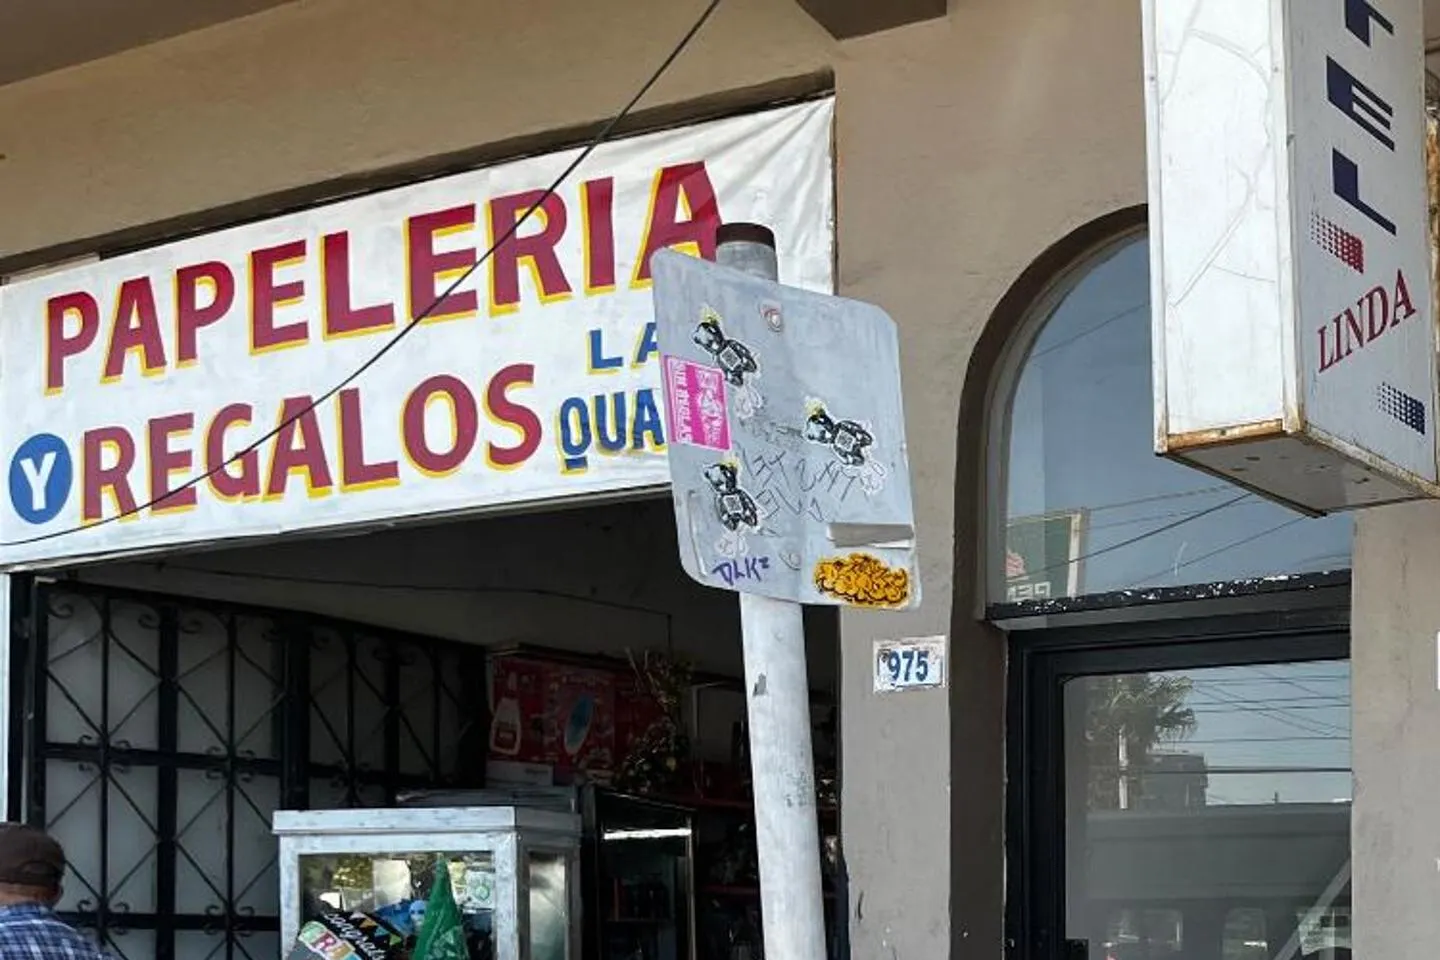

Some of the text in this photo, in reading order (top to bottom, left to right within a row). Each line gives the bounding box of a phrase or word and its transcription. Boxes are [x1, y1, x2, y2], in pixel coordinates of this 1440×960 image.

[45, 160, 722, 396] PAPELERIA
[1317, 267, 1417, 374] LINDA
[19, 363, 543, 524] Y REGALOS
[886, 650, 930, 682] 975
